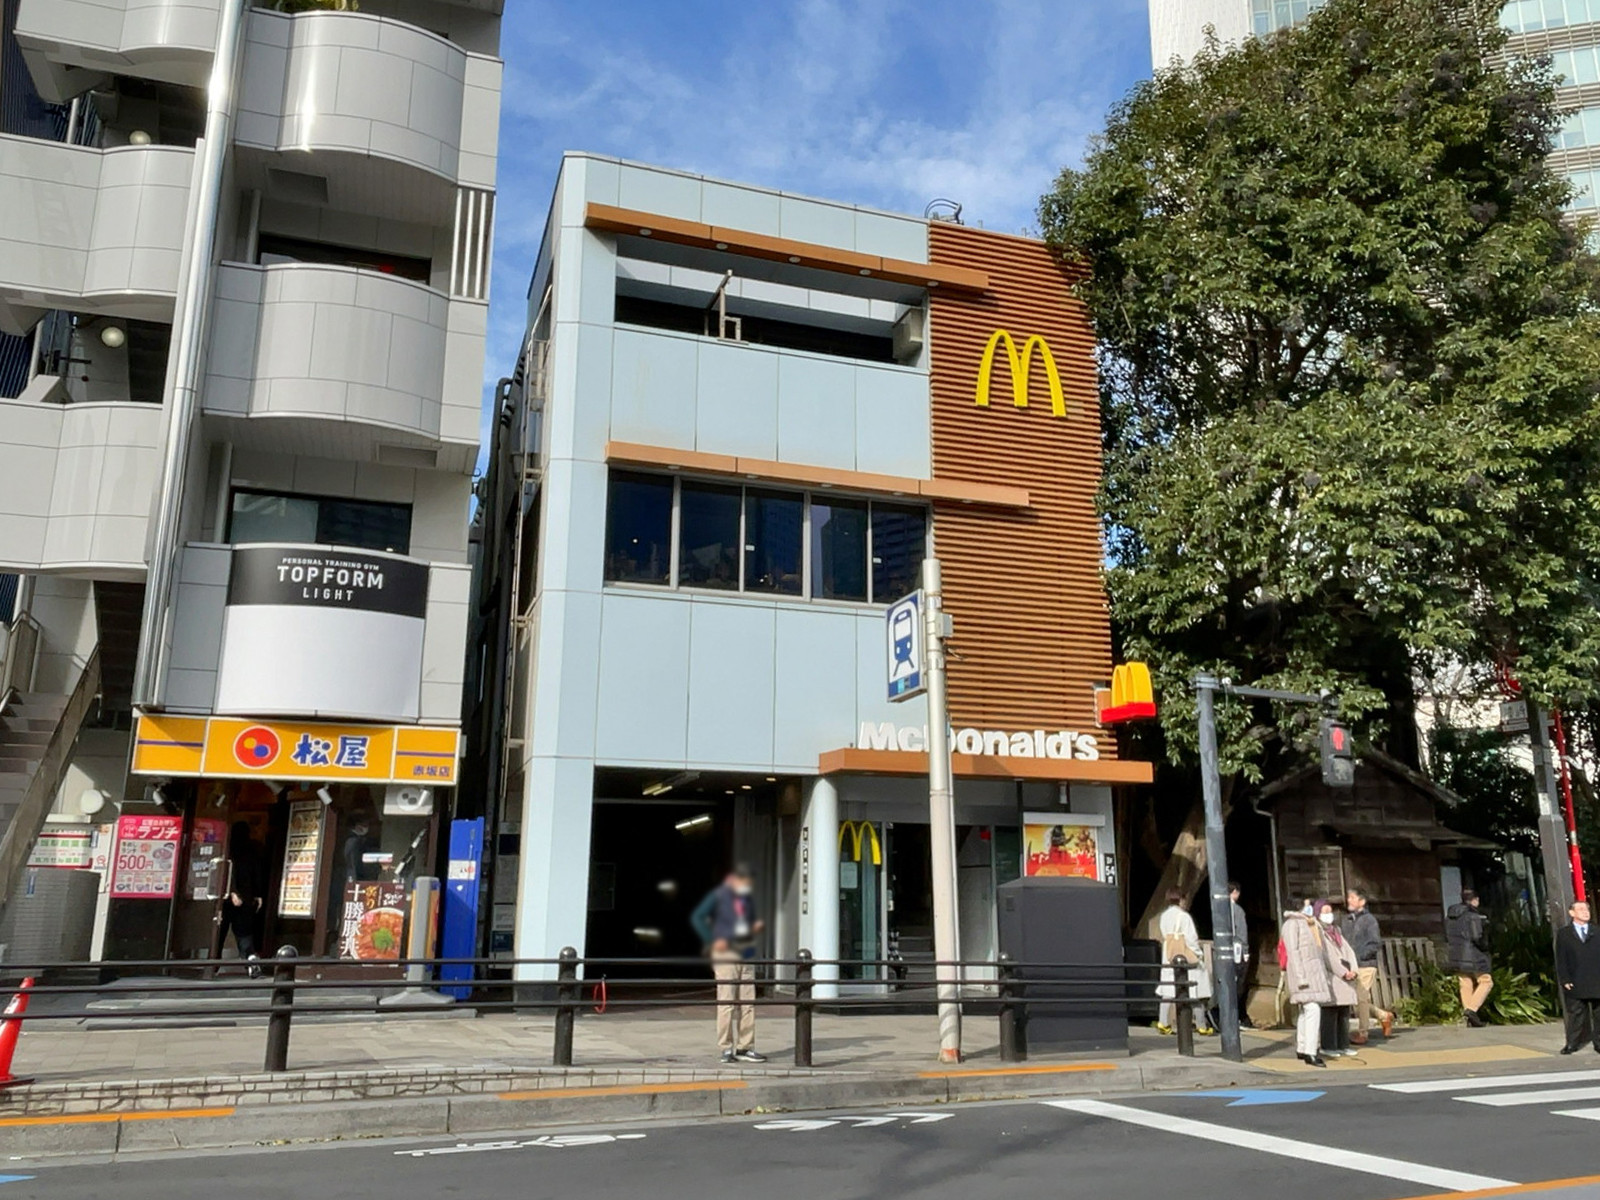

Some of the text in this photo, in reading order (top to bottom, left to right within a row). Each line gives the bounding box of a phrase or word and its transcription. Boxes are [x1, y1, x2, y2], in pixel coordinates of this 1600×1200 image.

[282, 557, 379, 571] PERSONAL TRAINING GYM
[277, 565, 384, 590] TOPFORM
[302, 587, 354, 601] LIGHT
[290, 733, 370, 768] 松屋
[413, 765, 450, 777] 赤坂店
[138, 825, 179, 839] ランチ
